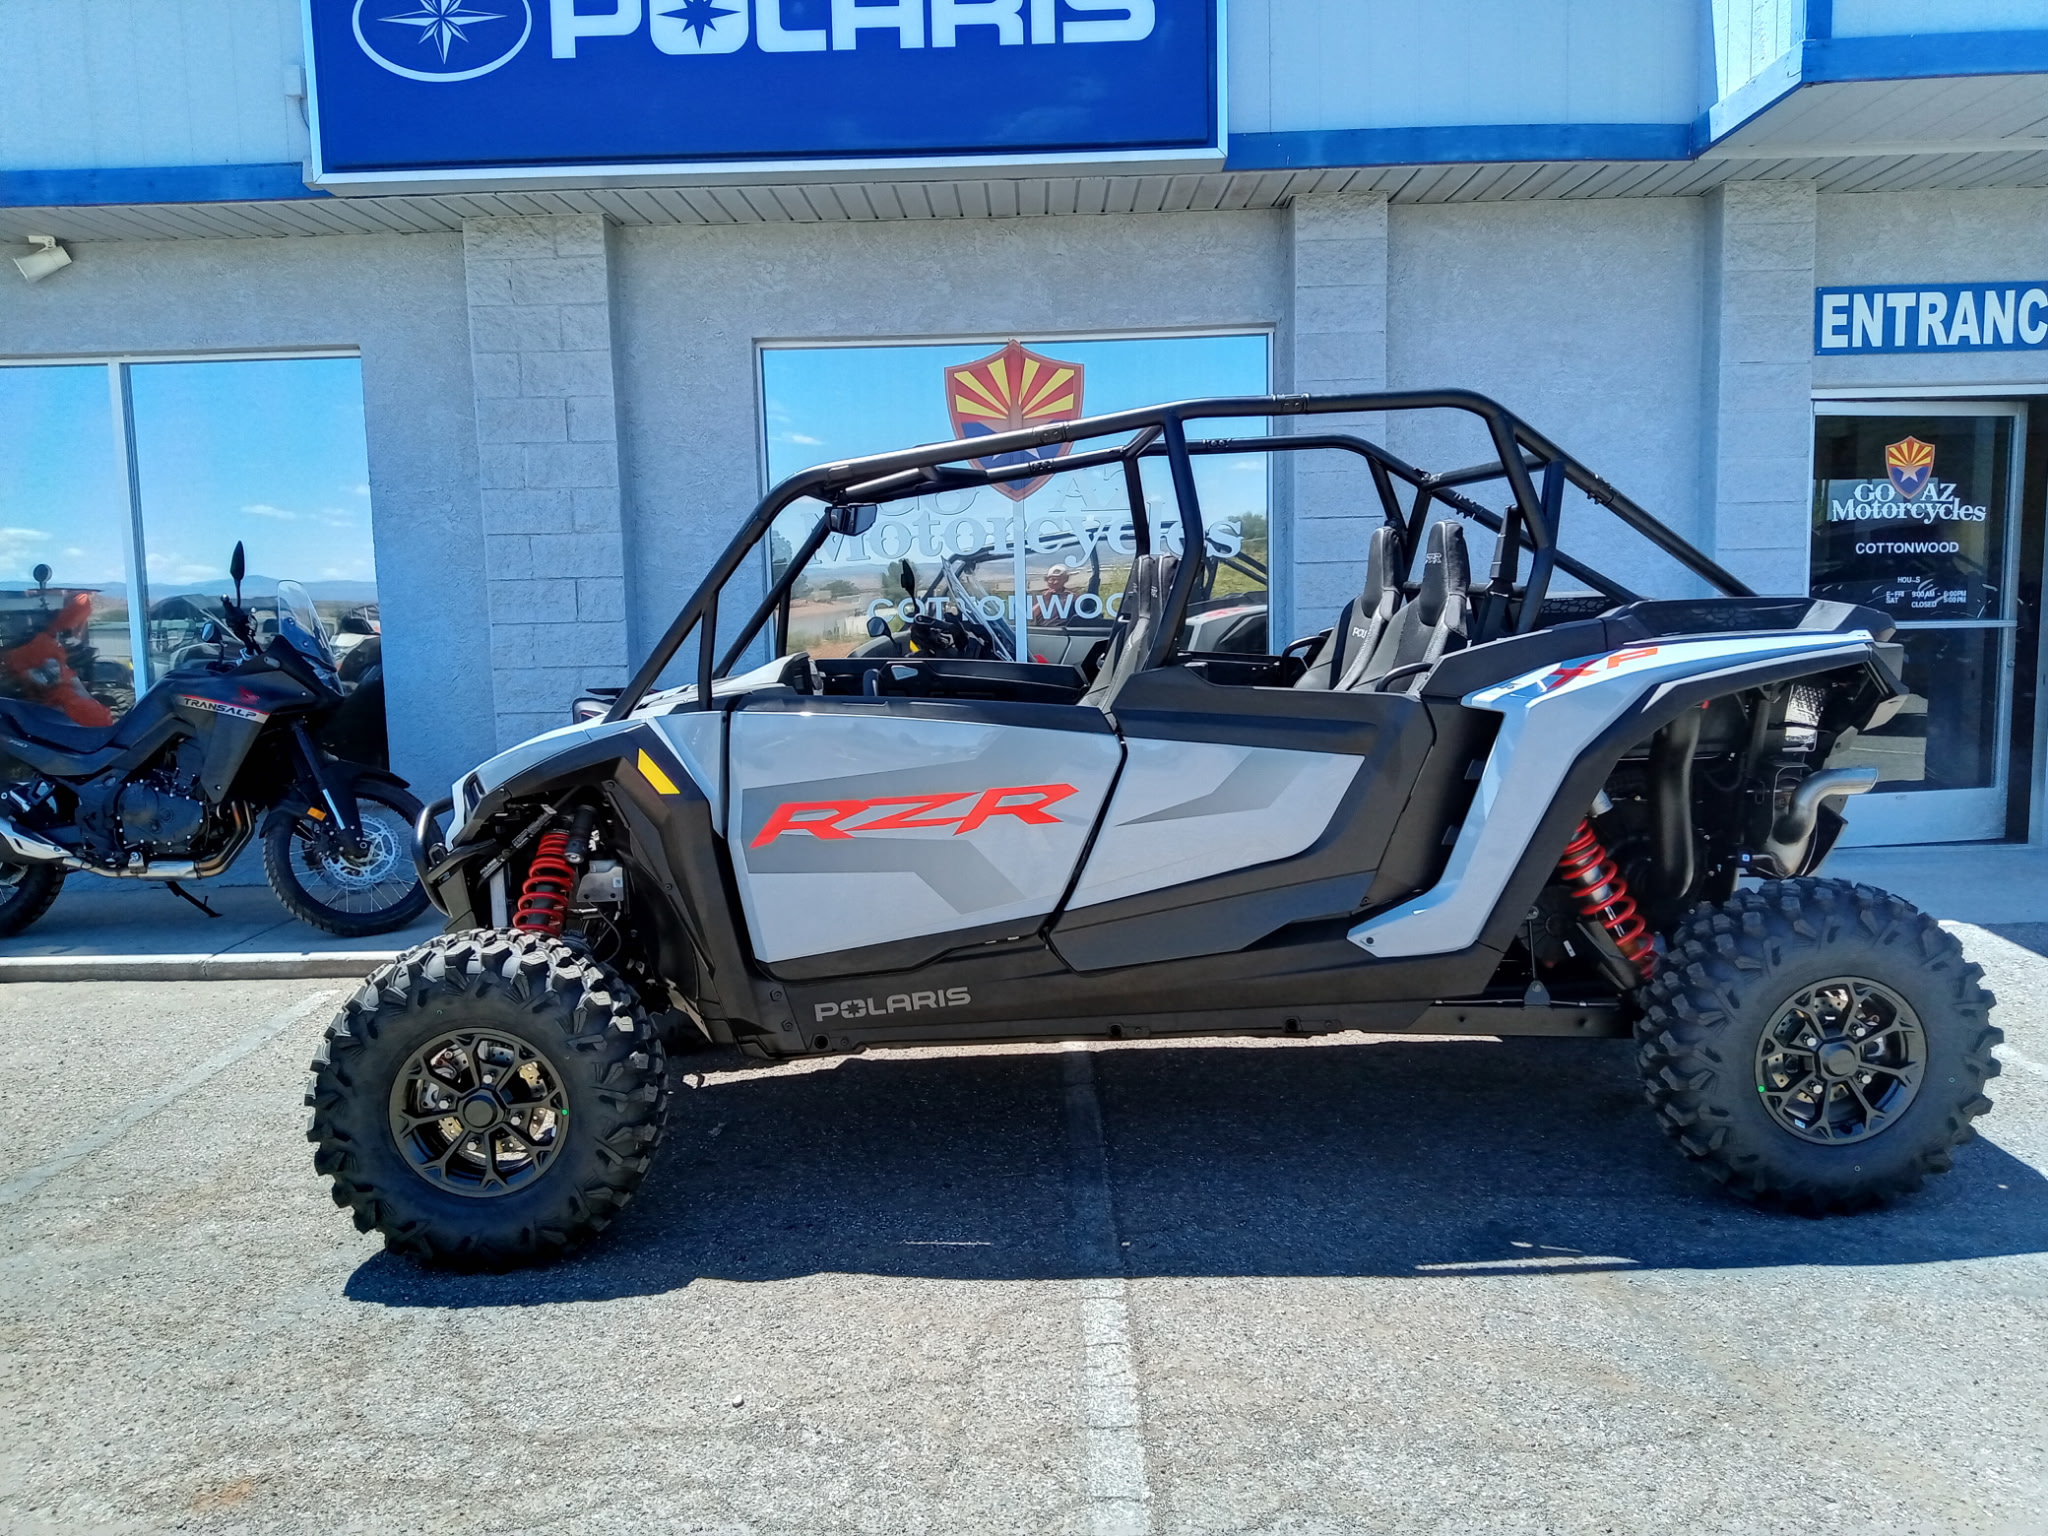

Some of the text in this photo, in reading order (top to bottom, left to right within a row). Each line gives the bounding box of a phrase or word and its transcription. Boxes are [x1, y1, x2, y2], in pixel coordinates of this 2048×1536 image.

[552, 0, 1156, 58] POLARIS
[1854, 483, 1957, 502] GO AZ
[1831, 497, 1987, 525] Motorcycles
[1855, 542, 1960, 554] COTTONWOOD
[1897, 576, 1921, 584] HOUS
[184, 698, 257, 718] TRANSALP
[750, 783, 1079, 849] RZR
[814, 987, 971, 1022] POLARIS
